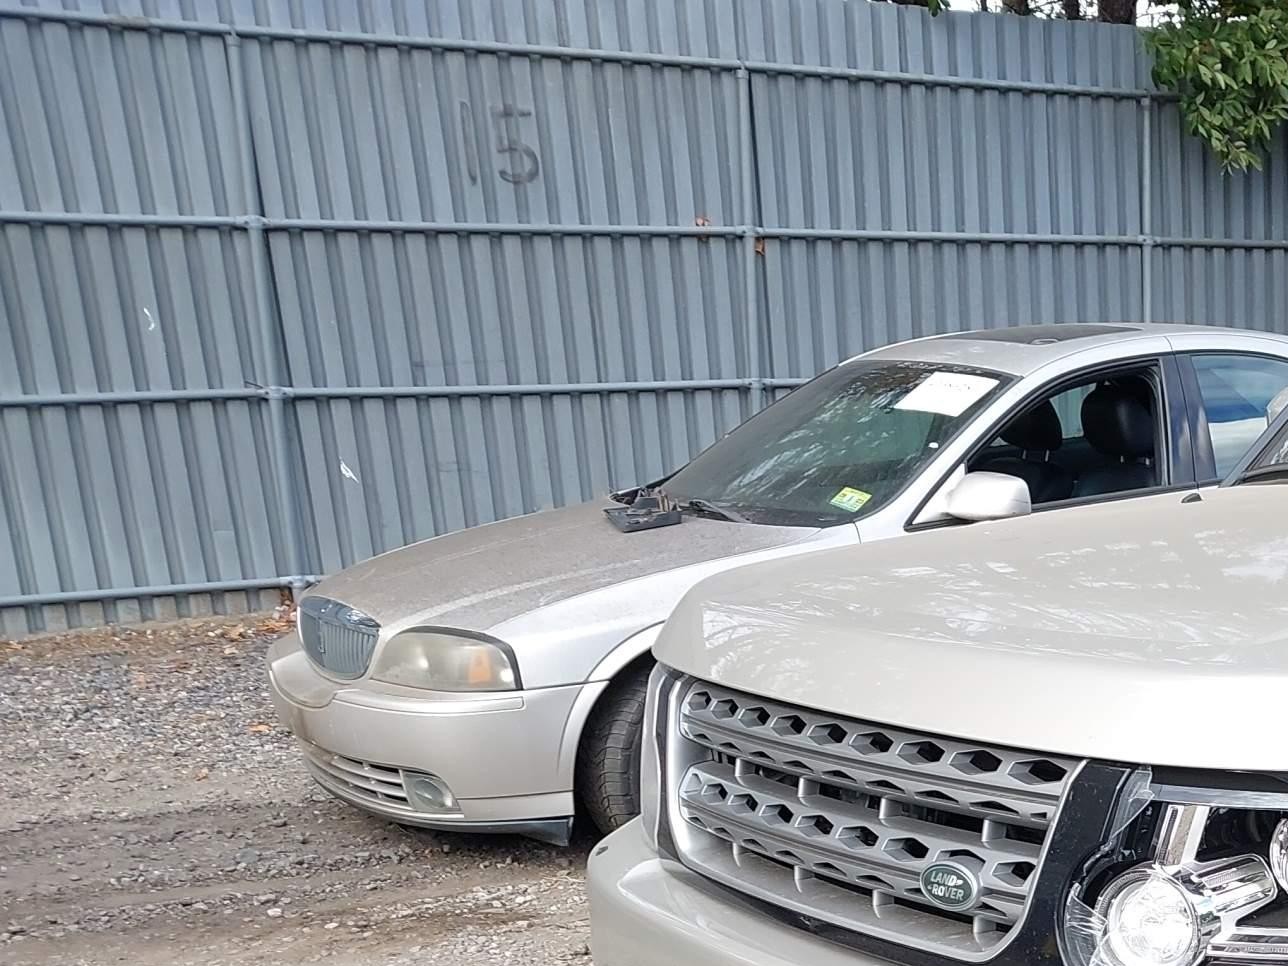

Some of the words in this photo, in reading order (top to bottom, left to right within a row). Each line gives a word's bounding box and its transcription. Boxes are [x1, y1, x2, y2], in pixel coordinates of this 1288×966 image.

[459, 100, 540, 187] 15
[930, 870, 958, 886] LAND
[931, 883, 965, 901] ROVER
